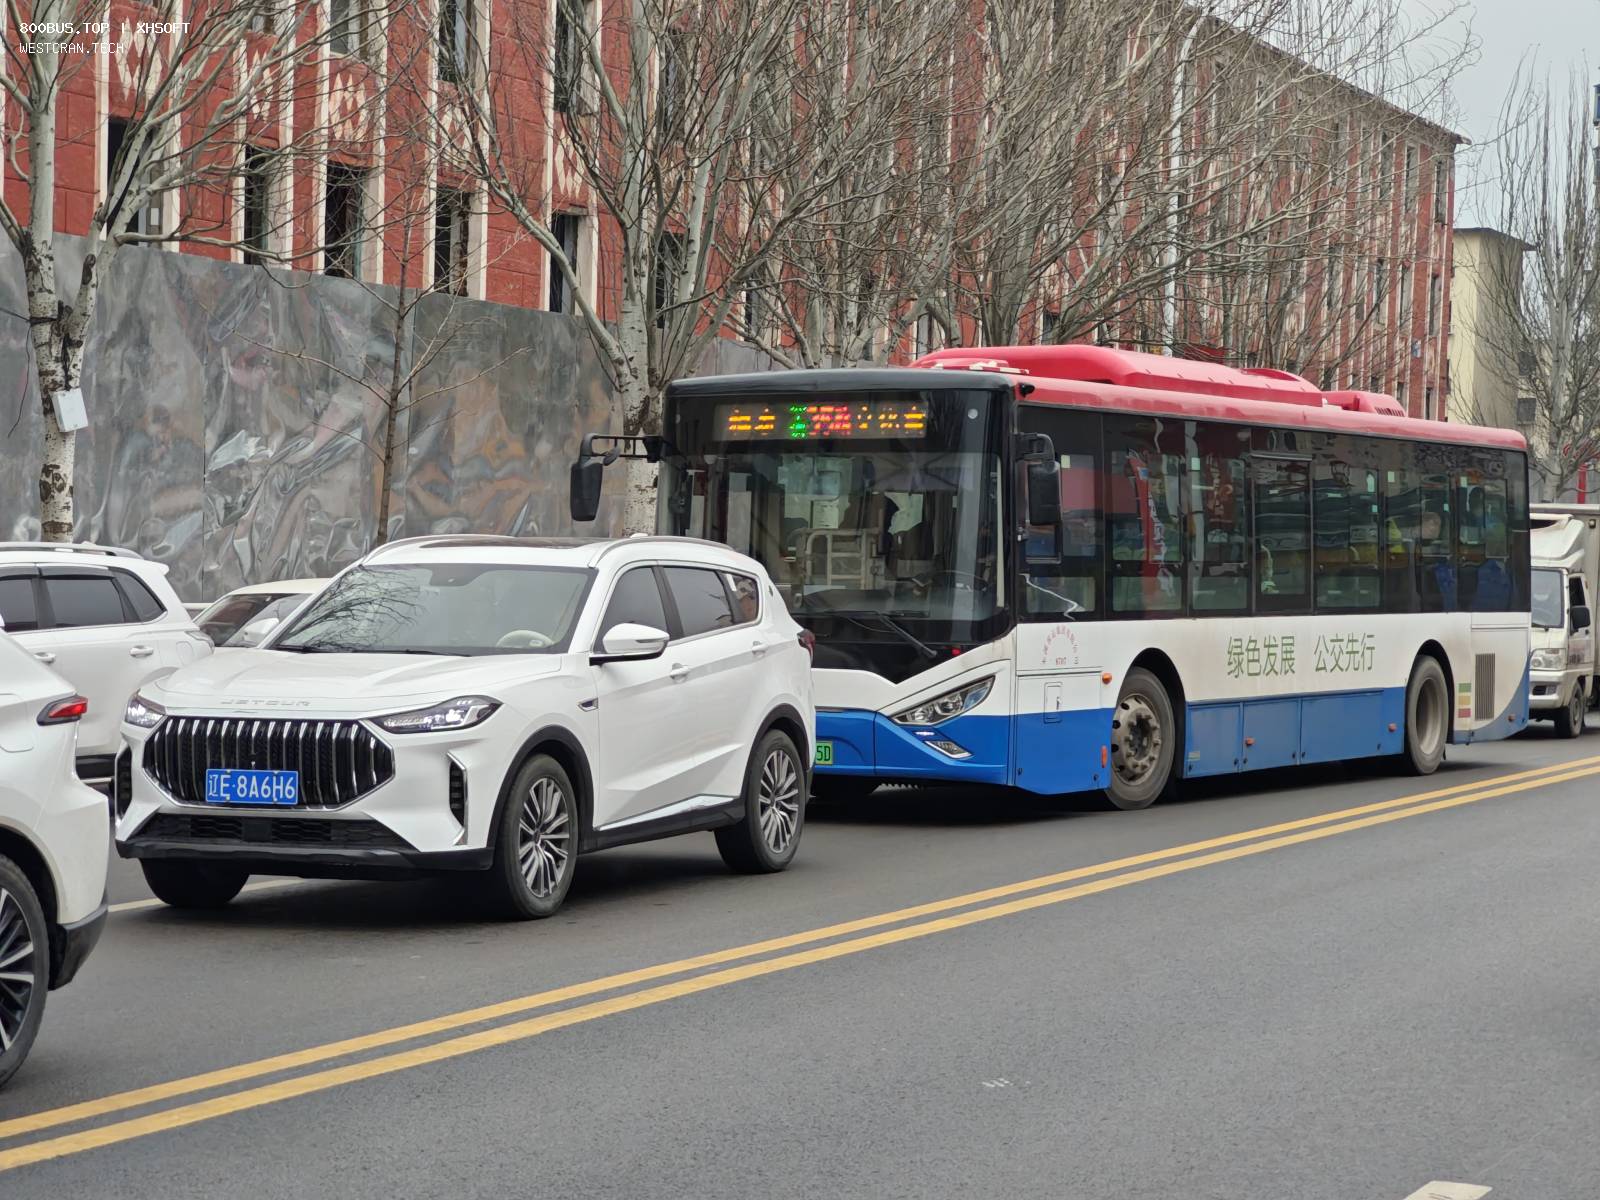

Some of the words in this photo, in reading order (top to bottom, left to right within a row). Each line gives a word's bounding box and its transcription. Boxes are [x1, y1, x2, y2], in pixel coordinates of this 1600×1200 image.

[1227, 634, 1296, 679] 绿色发展
[1313, 631, 1376, 673] 公交先行
[220, 699, 311, 707] JETOUR
